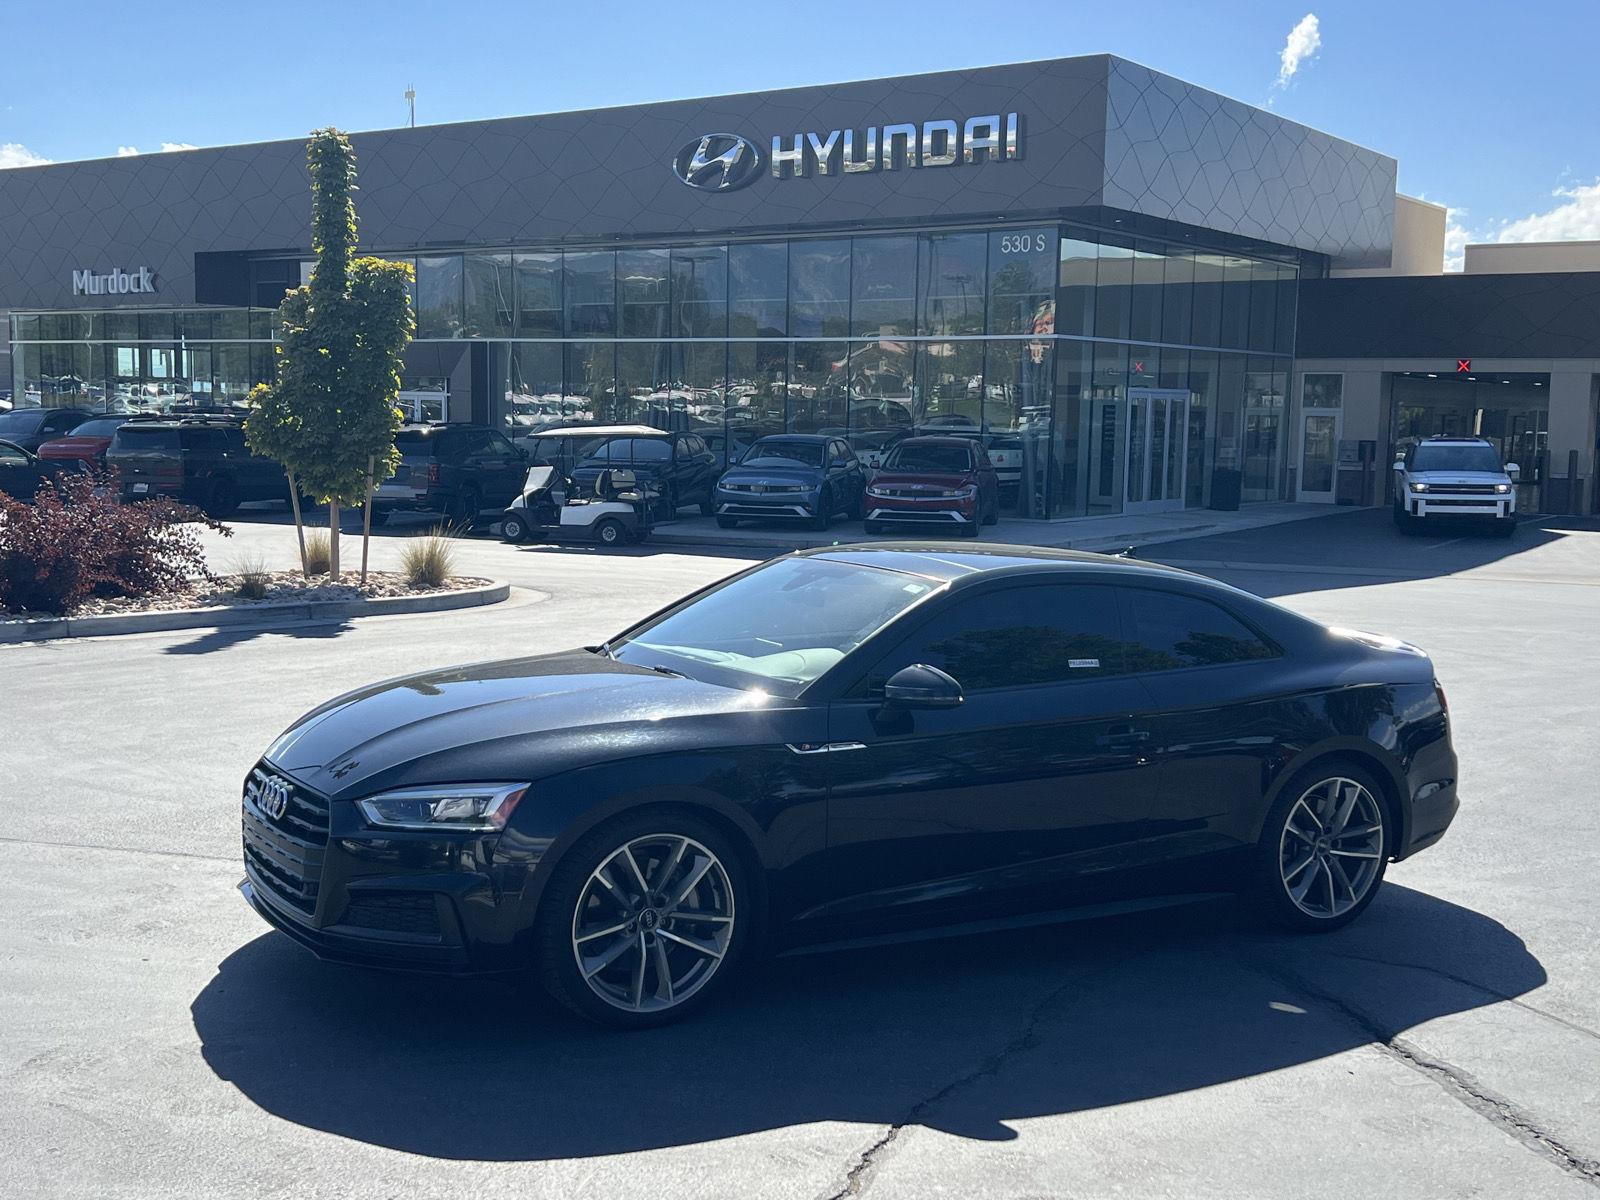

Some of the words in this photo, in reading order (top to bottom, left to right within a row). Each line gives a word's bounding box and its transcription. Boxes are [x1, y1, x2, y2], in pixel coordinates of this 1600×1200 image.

[770, 112, 1020, 179] HYUNDAI
[1001, 235, 1031, 253] 530
[1035, 234, 1046, 252] S
[72, 266, 156, 295] Murdock
